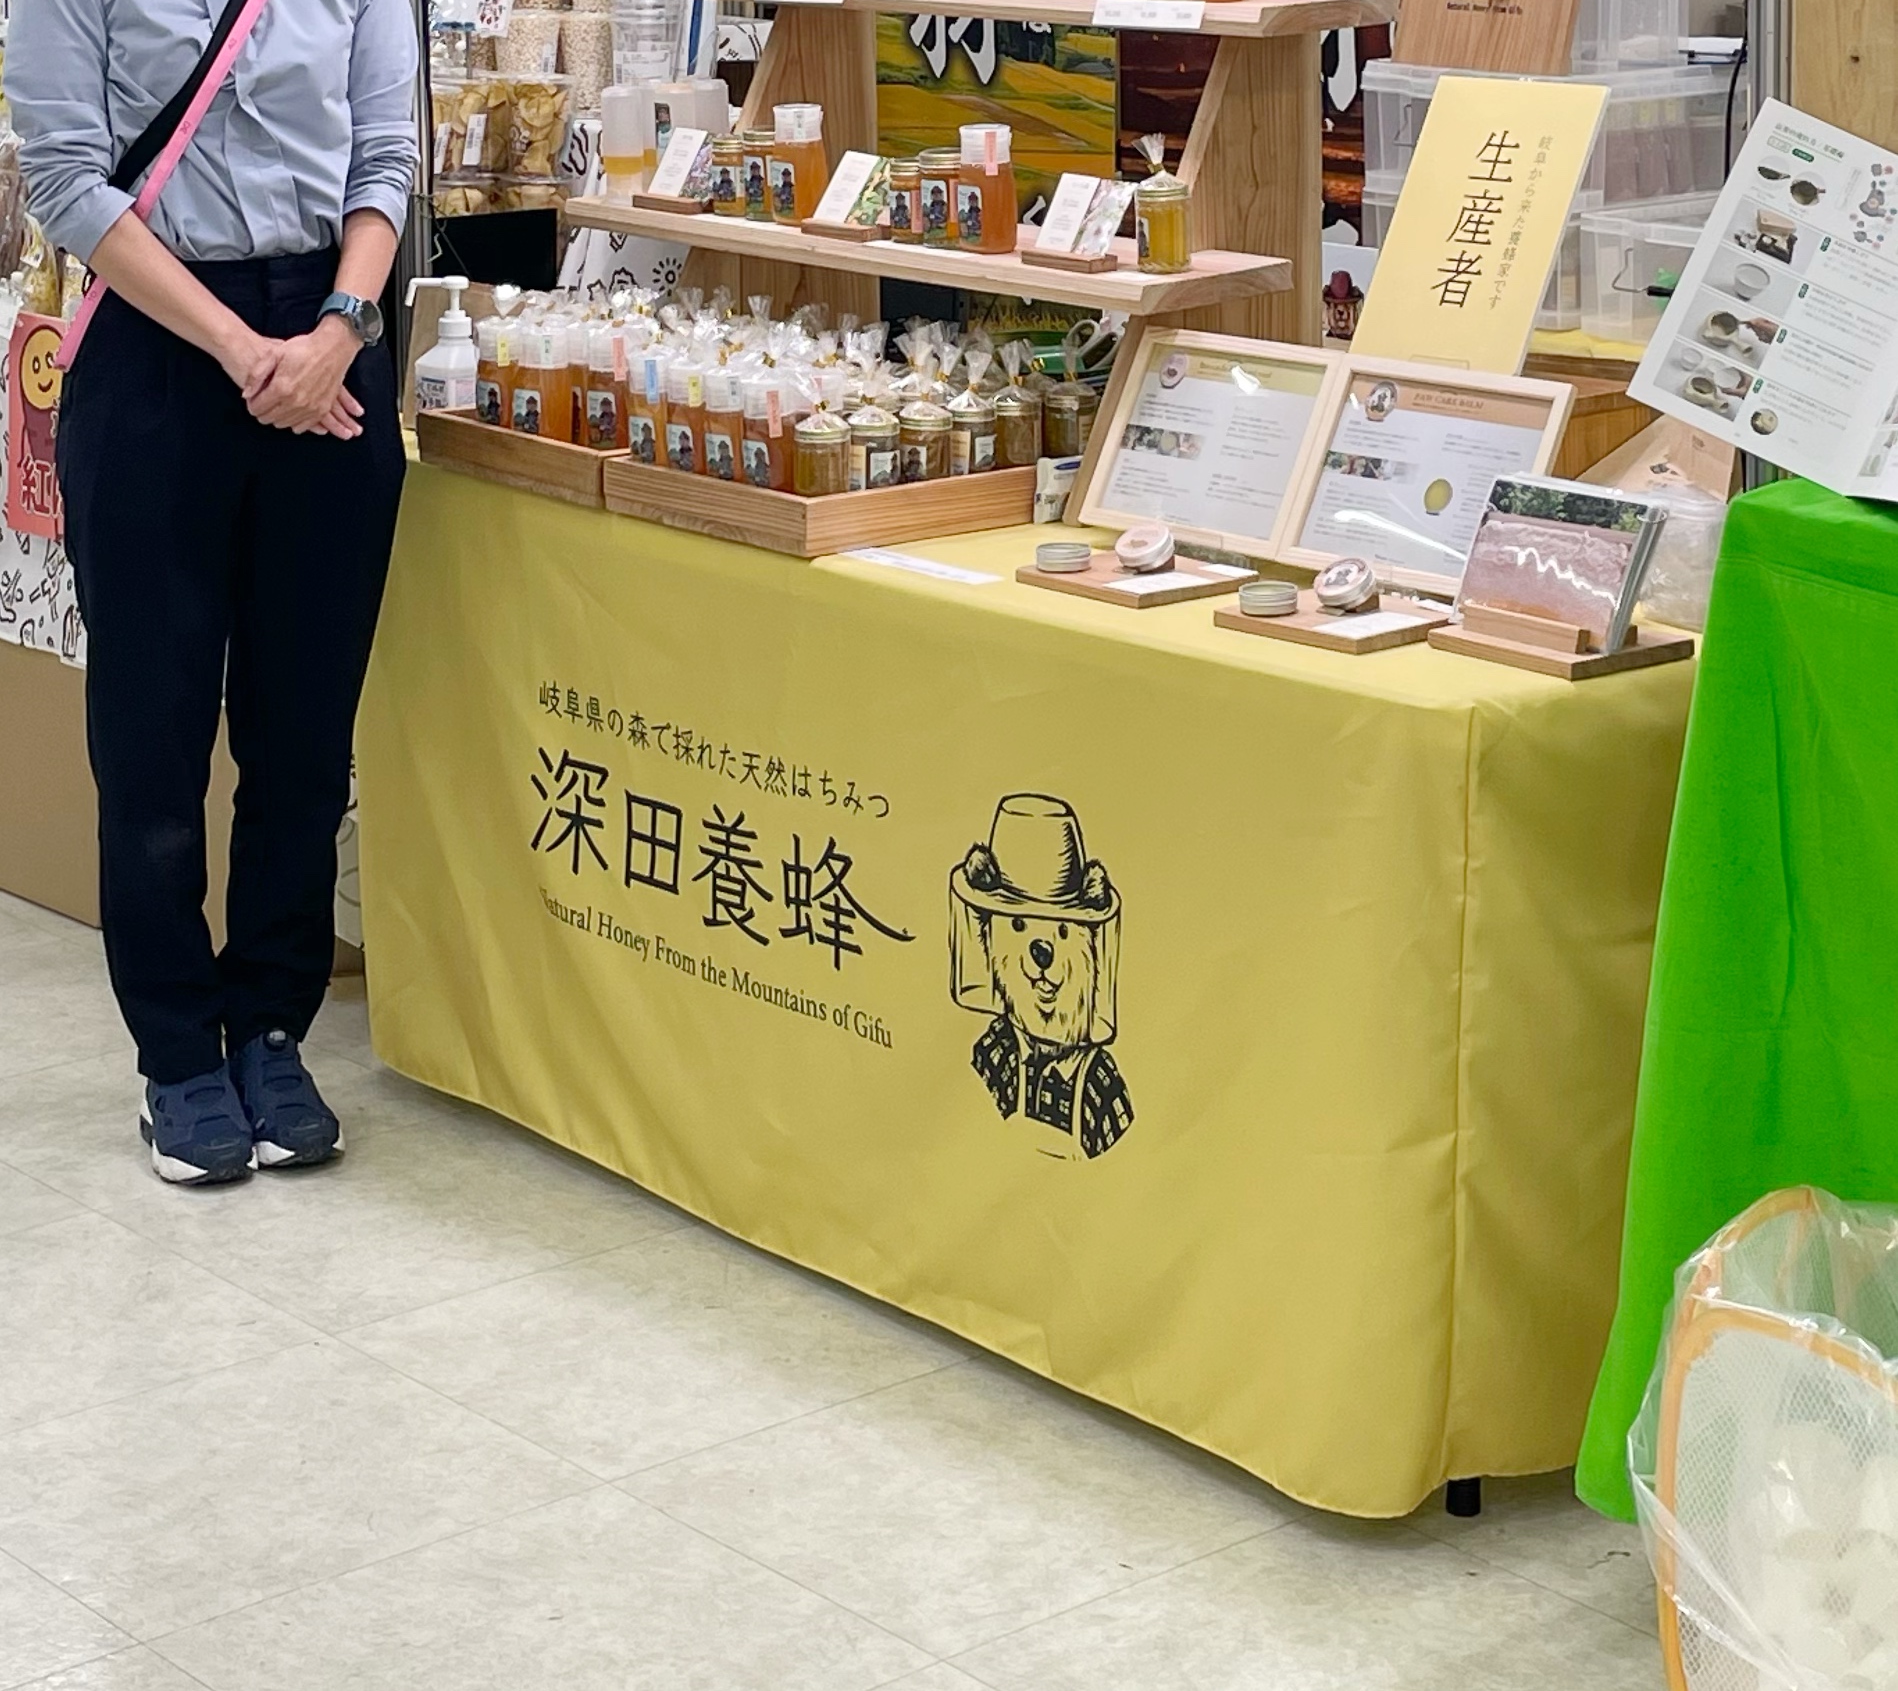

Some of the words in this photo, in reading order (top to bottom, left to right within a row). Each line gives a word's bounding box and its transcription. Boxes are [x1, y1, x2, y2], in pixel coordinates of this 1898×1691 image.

[1430, 129, 1521, 308] 生産者
[539, 680, 890, 818] 岐阜県の森で採れた天然はちみつ
[530, 746, 918, 971] 深田養蜂
[598, 911, 650, 962] Honey
[655, 935, 697, 976] From
[700, 954, 728, 988] the
[731, 966, 828, 1021] Mountains
[832, 1004, 851, 1032] of
[853, 1011, 894, 1049] Gifu
